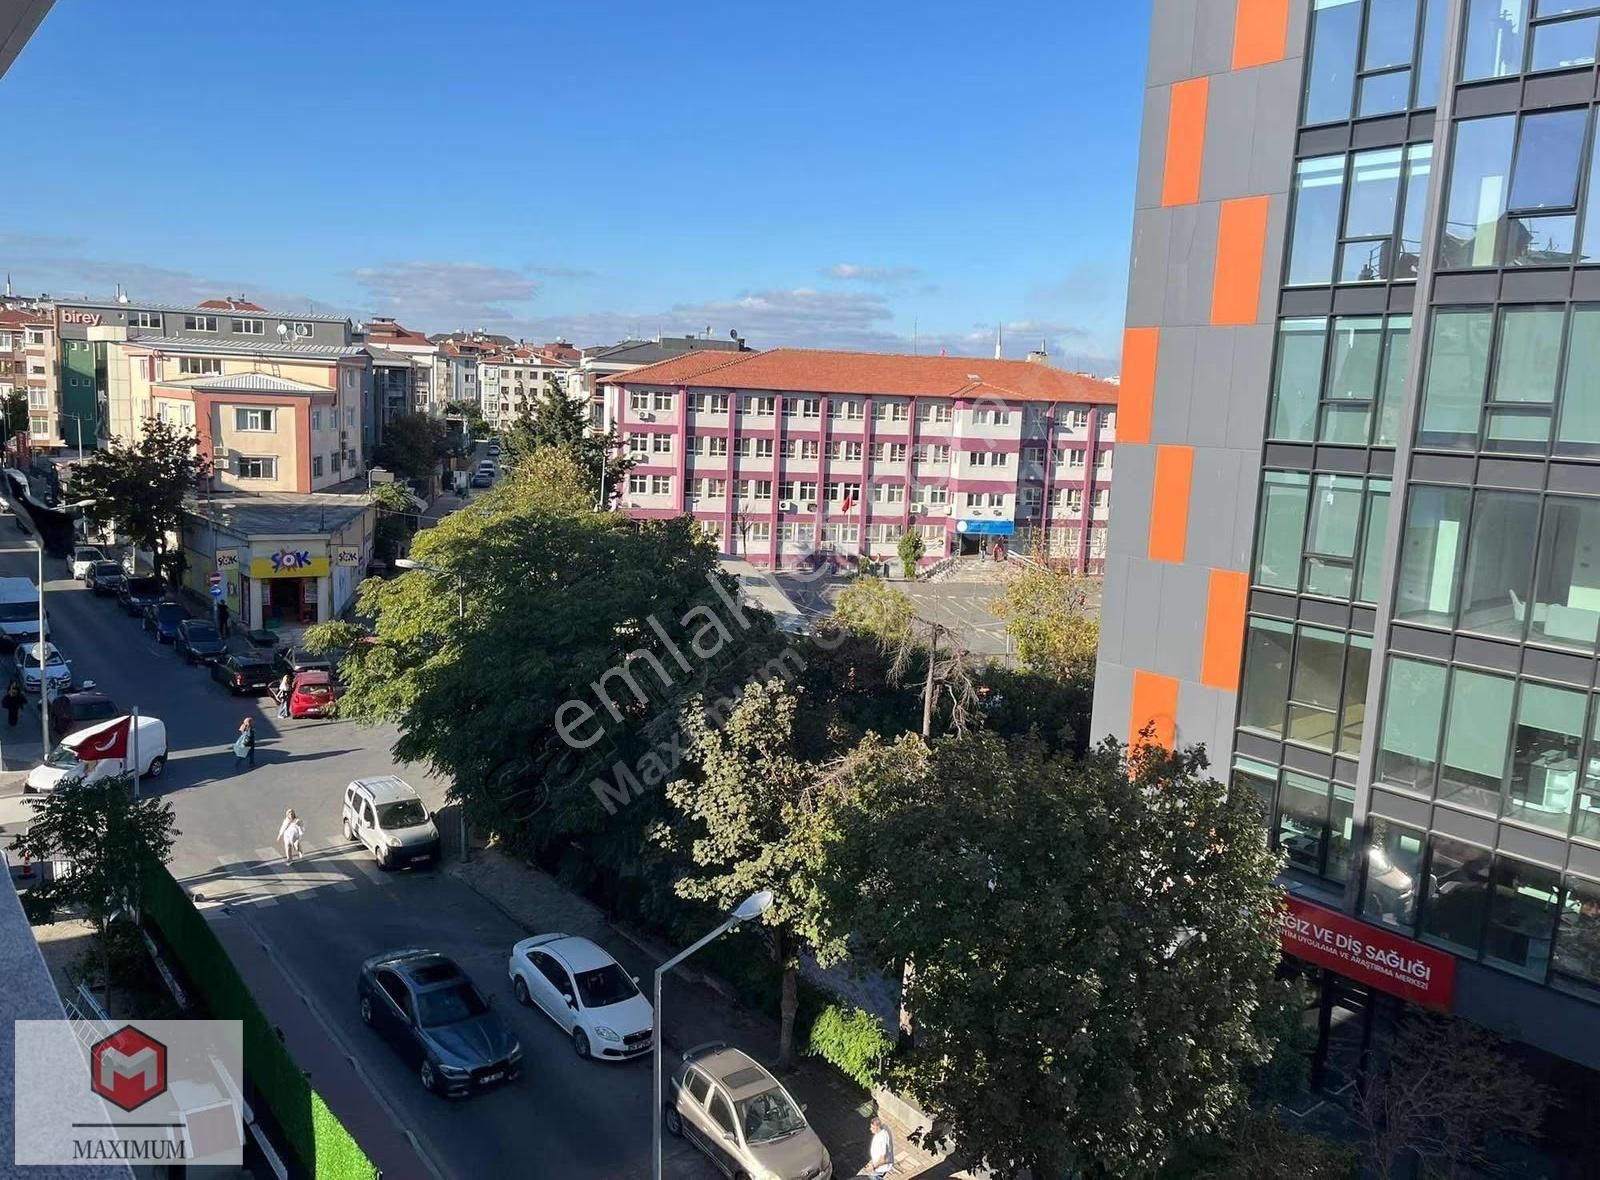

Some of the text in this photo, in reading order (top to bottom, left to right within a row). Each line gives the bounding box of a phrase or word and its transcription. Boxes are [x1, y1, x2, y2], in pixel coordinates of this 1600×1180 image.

[62, 310, 100, 326] birey
[1298, 935, 1338, 956] UYGULAMA
[1339, 950, 1350, 960] VE
[1351, 955, 1394, 977] ARAŞTIRMA
[1313, 924, 1334, 944] VE
[1336, 933, 1362, 956] DİŞ
[1365, 945, 1431, 981] SAĞLIĞI
